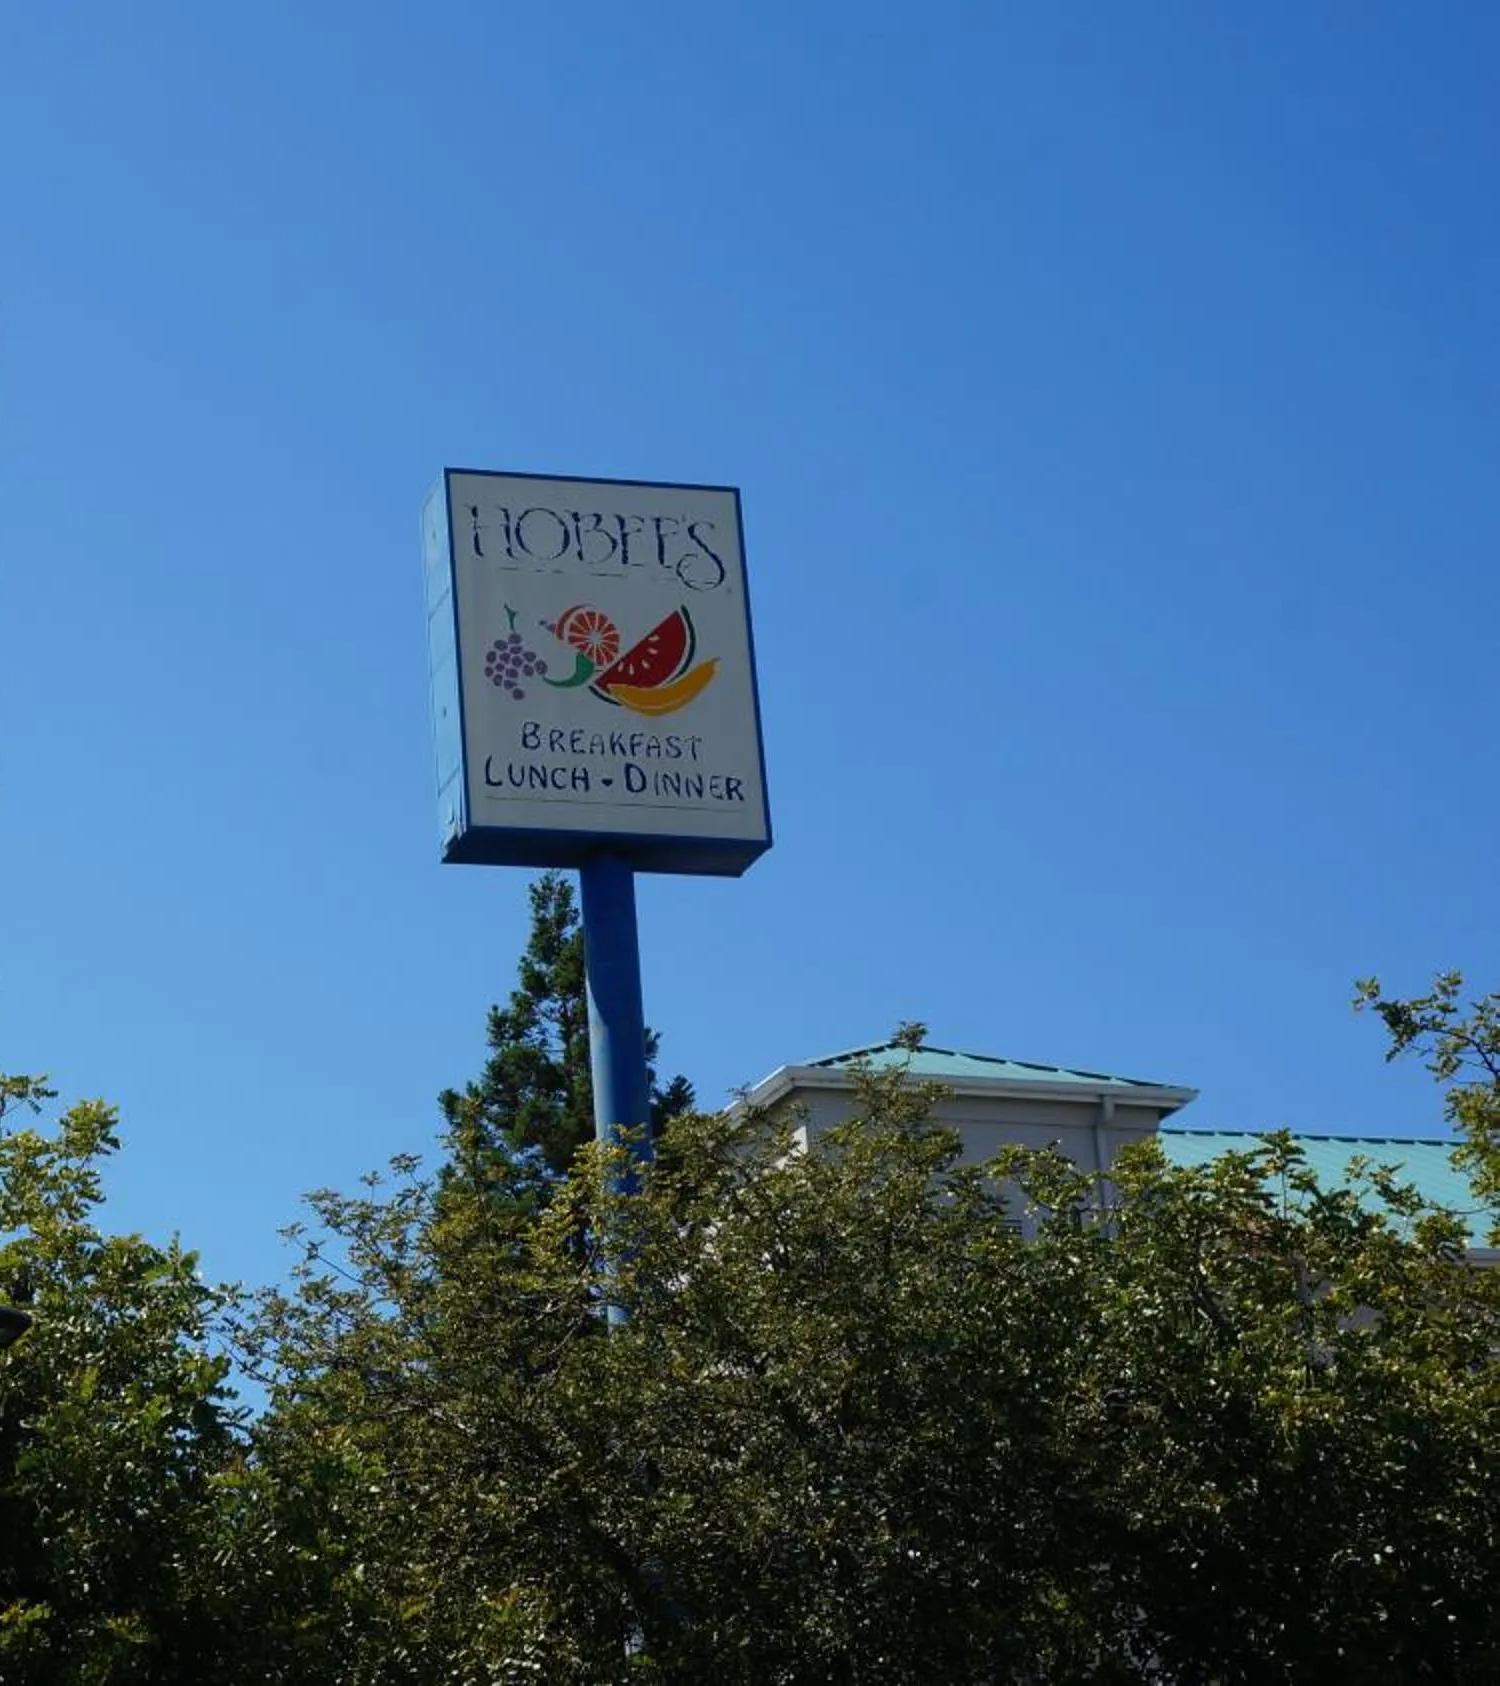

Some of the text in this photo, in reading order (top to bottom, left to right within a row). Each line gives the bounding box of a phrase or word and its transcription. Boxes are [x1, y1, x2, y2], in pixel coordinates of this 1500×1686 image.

[521, 721, 703, 761] BREAKFAST
[484, 754, 746, 802] LUNCH DINNER
